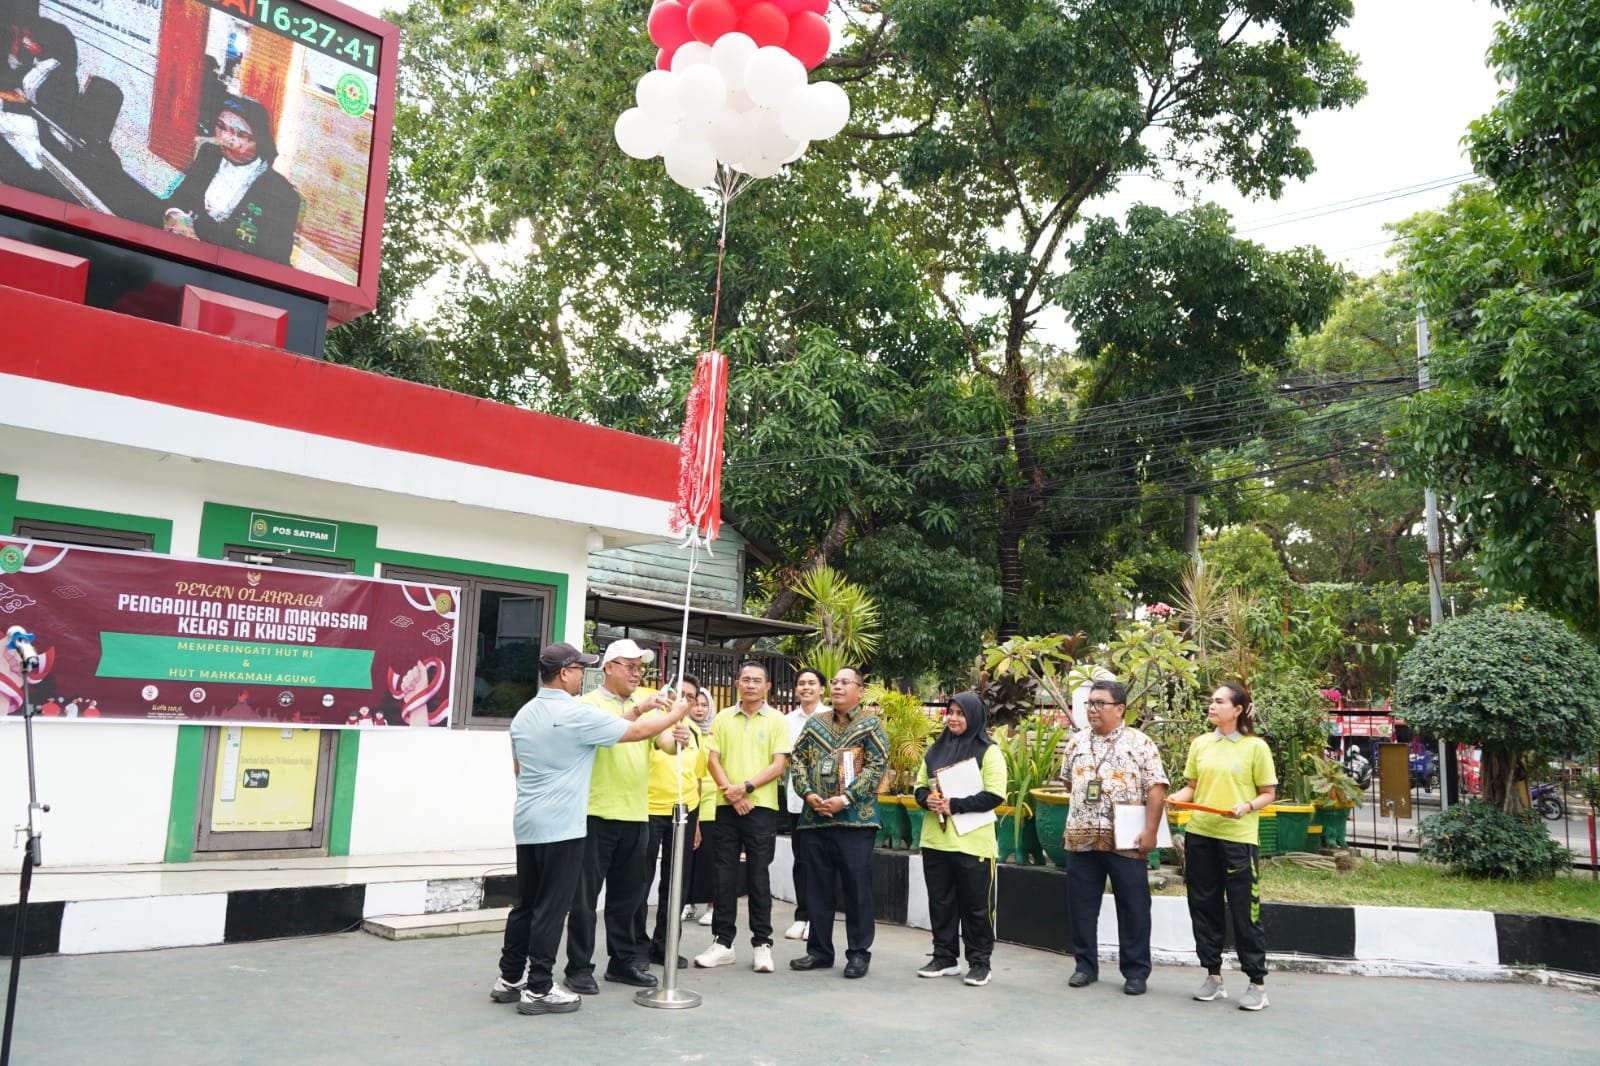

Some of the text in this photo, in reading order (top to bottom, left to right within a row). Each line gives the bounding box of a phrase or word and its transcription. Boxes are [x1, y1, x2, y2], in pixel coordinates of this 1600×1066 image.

[257, 0, 375, 68] 16:27:41
[272, 526, 329, 541] POS SATPAM
[175, 581, 325, 608] PEKAN OLAHRAGA
[118, 593, 368, 631] PENGADILAN NEGERI MAKASSAR
[177, 616, 317, 643] KELAS IA KHUSUS
[177, 641, 313, 659] MEMPERINGATI HUT RI
[242, 659, 251, 668] &
[168, 668, 317, 684] HUT MAHKAMAH AGUNG
